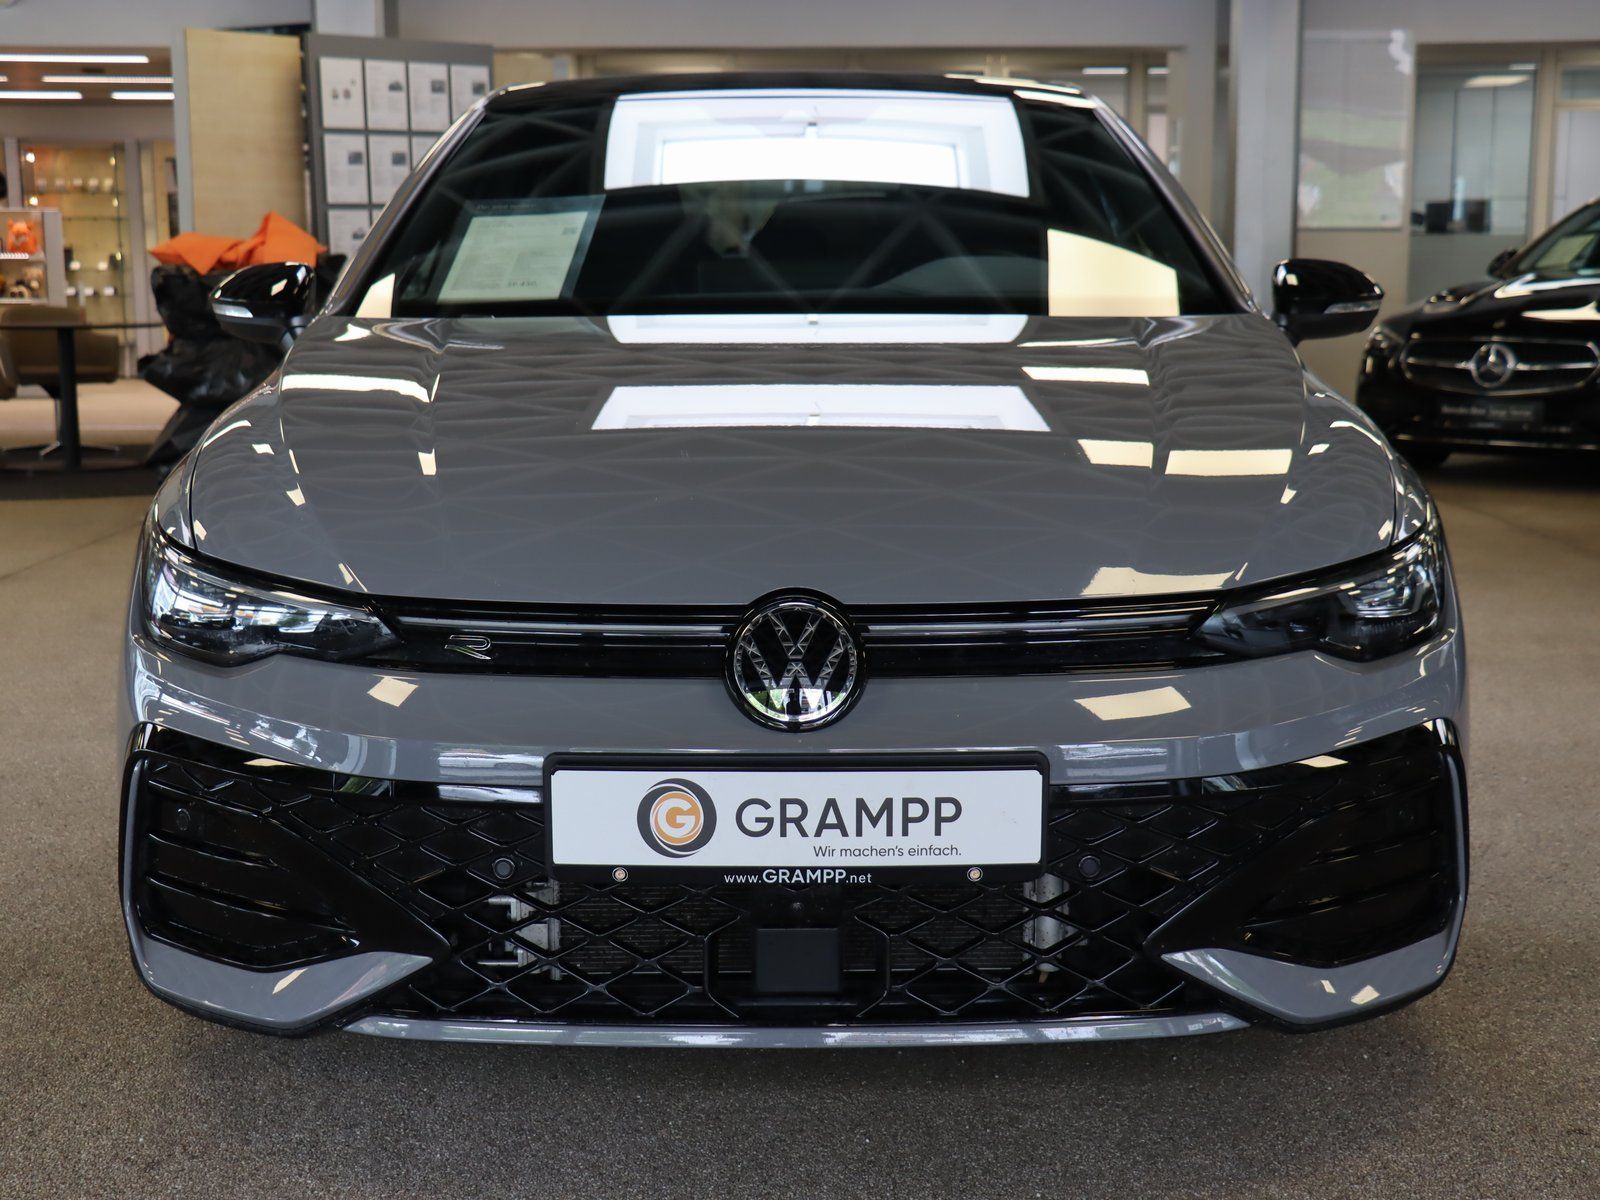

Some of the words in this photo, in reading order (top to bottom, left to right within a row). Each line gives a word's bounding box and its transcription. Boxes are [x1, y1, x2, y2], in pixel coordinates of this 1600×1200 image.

[735, 796, 963, 838] GRAMPP
[813, 845, 836, 858] Wir
[840, 845, 904, 858] machen's
[908, 844, 962, 857] einfach.
[723, 868, 873, 884] www.GRAMPP.net
